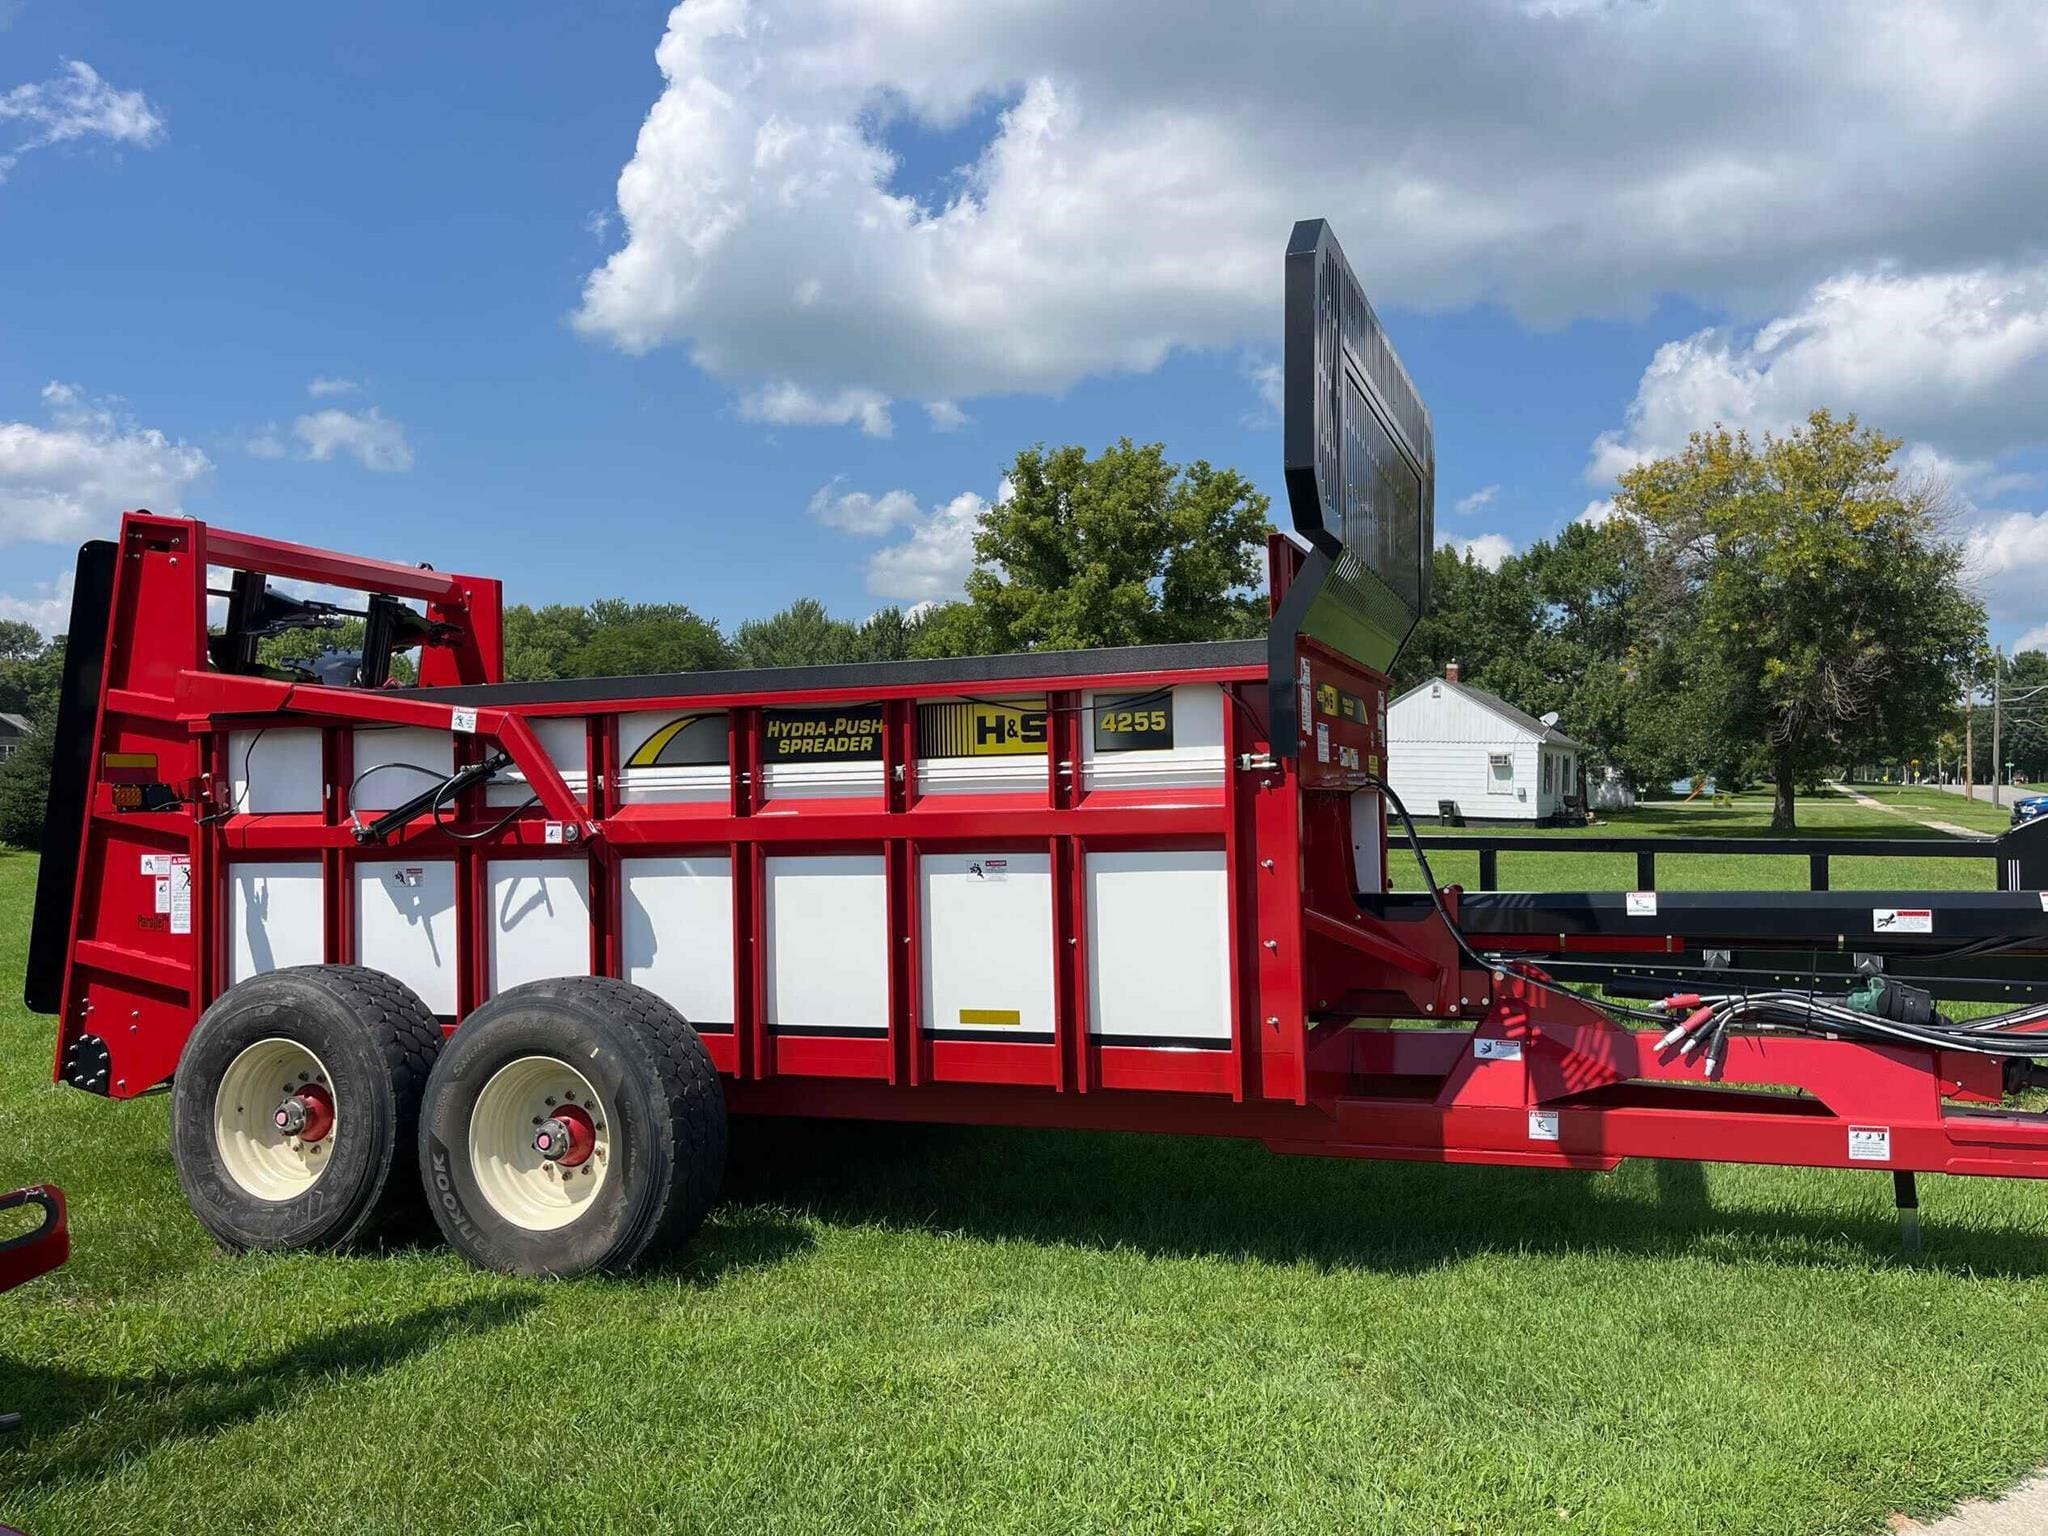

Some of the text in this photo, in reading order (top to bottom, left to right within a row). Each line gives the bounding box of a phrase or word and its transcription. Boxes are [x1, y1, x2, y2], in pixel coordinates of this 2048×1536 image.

[766, 717, 883, 737] HYDRA-PUSH
[976, 713, 1048, 745] H&S
[1101, 711, 1166, 733] 4255
[778, 737, 873, 754] SPREADER
